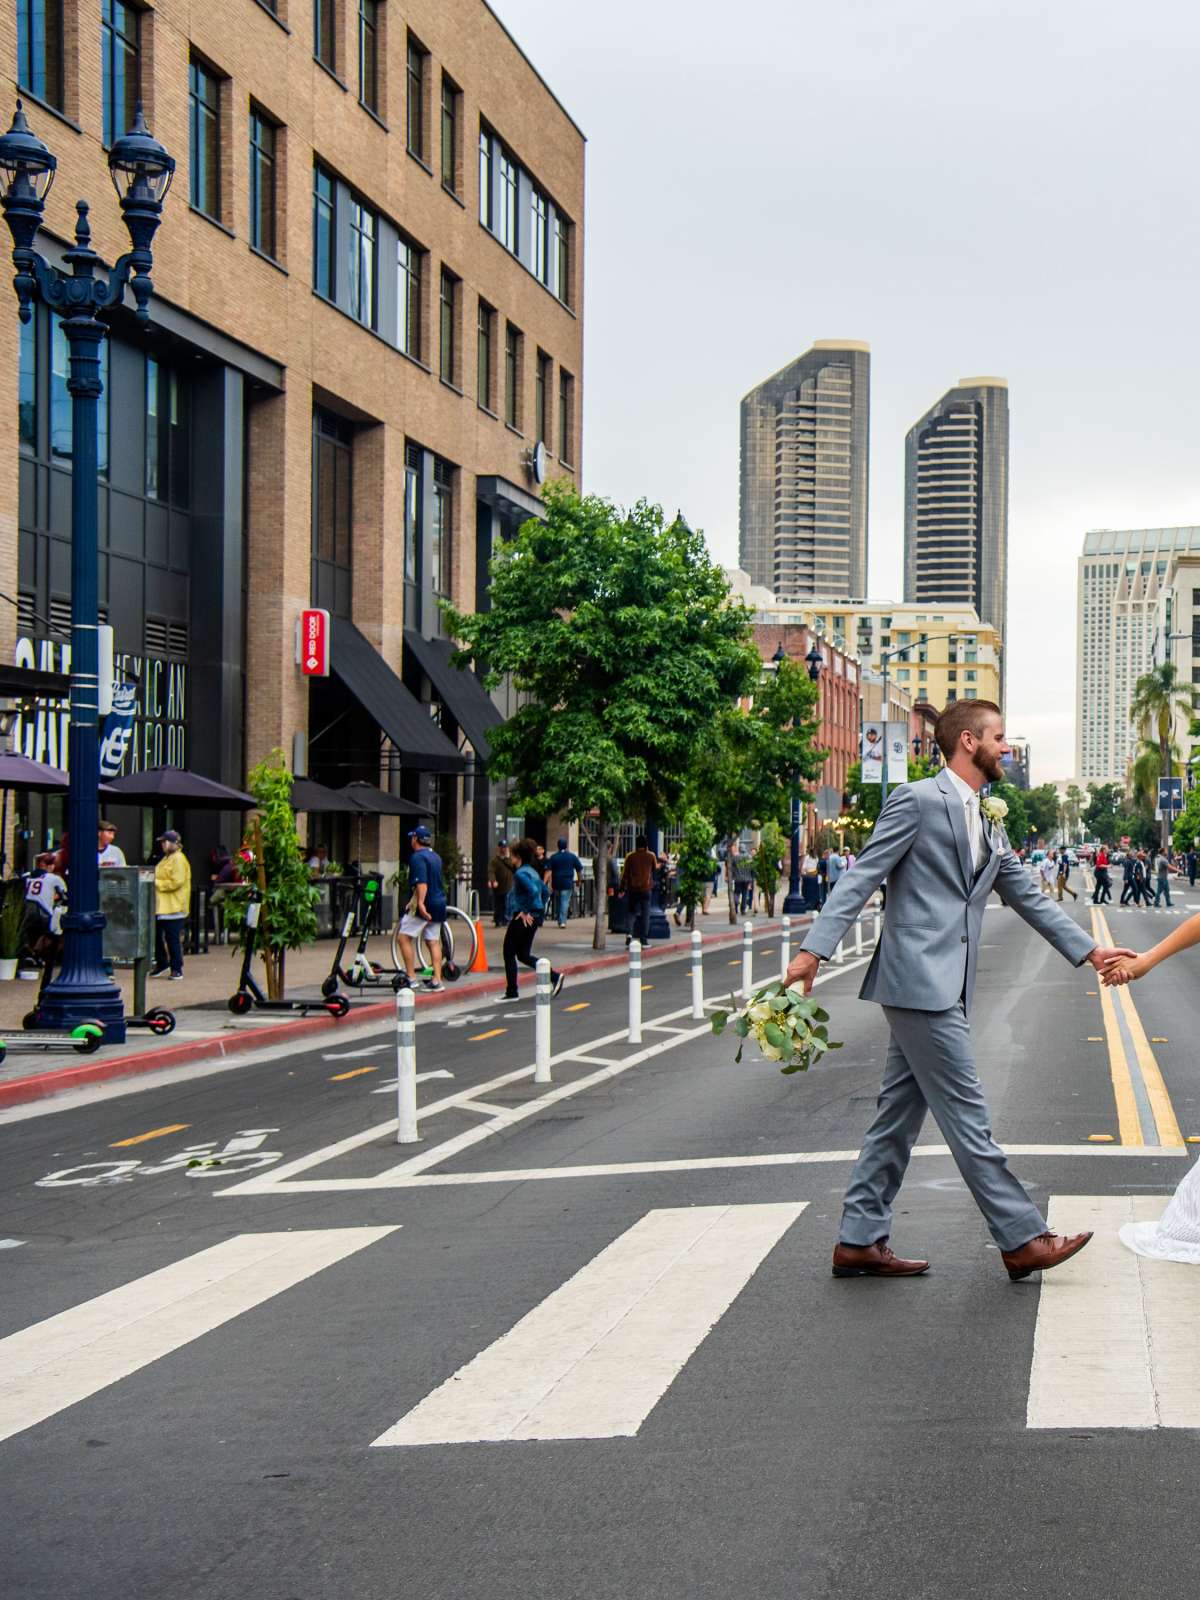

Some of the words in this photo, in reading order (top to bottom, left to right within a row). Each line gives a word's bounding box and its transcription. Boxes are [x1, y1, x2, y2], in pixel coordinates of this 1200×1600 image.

[308, 615, 316, 639] DOOR
[308, 639, 316, 656] RED
[116, 654, 186, 720] EXICAN
